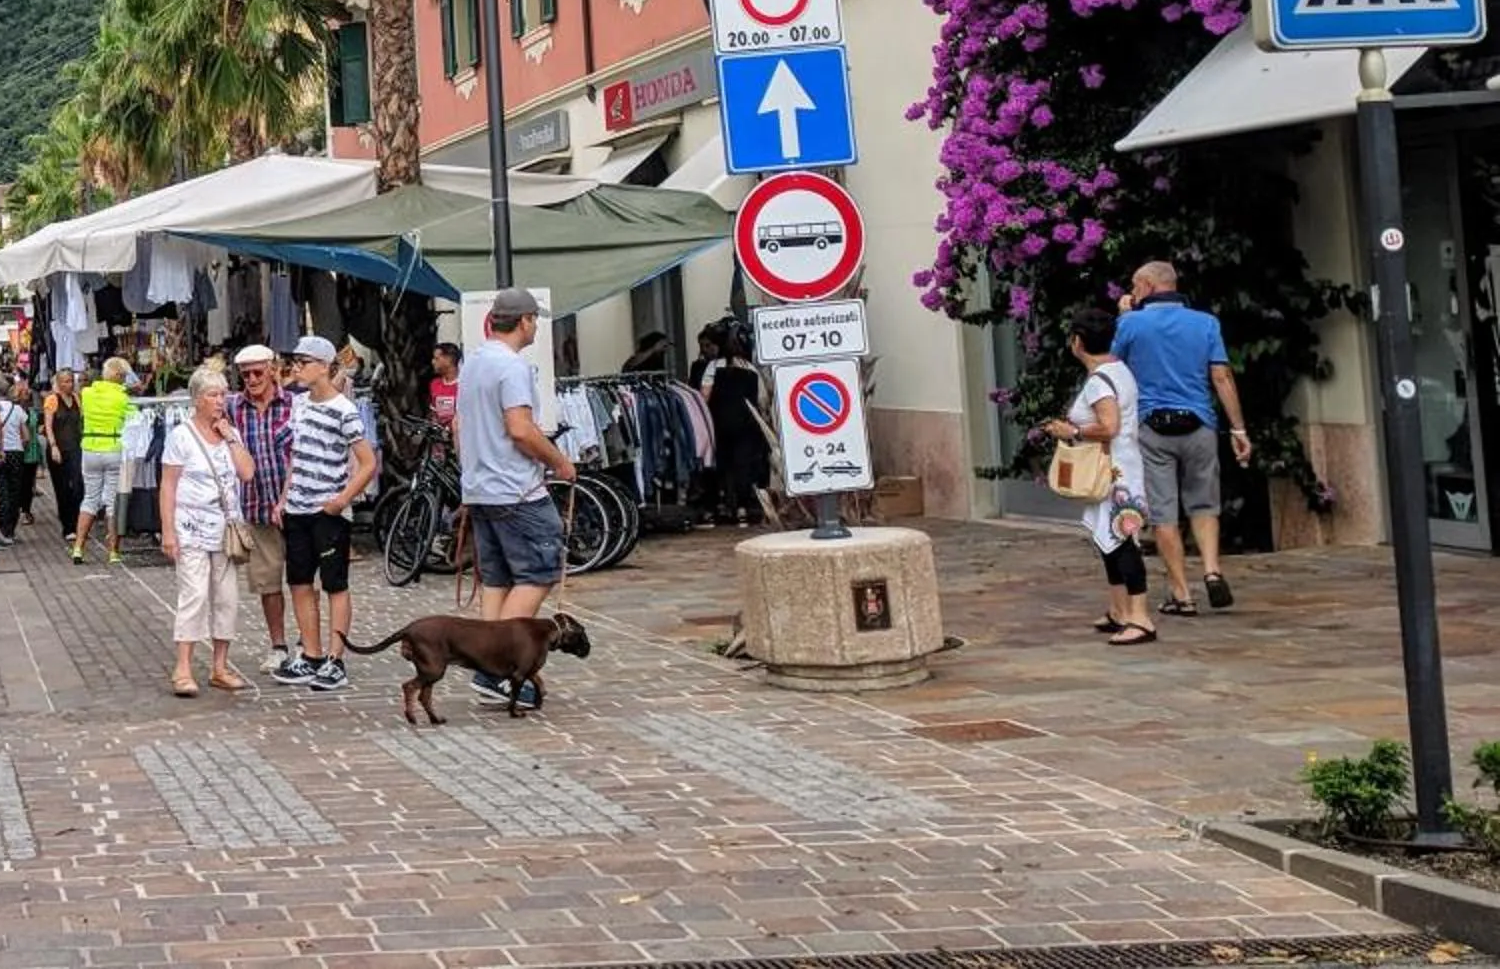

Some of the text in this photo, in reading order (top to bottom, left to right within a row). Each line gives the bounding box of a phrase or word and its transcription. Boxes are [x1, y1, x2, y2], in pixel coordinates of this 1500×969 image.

[728, 31, 770, 47] 20.00
[790, 26, 831, 42] 07.00
[634, 67, 697, 110] HONDA
[762, 311, 859, 330] eccetto autorizzati
